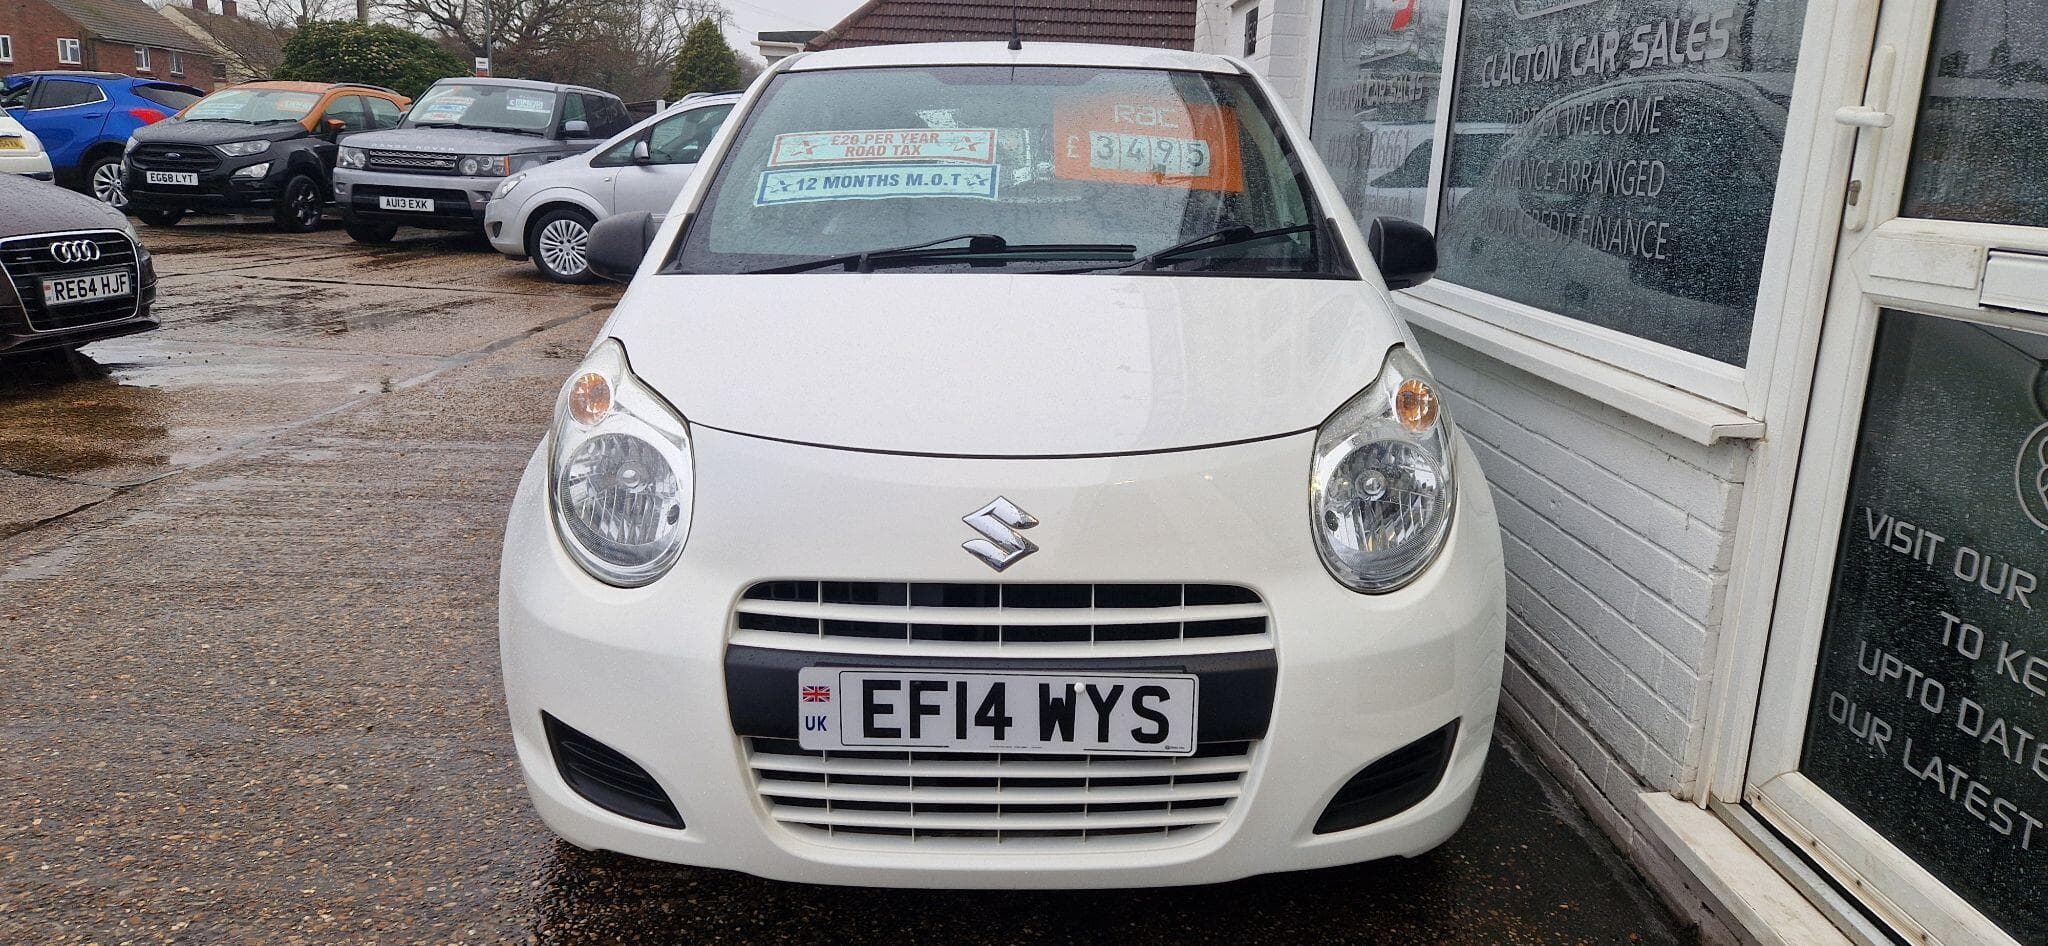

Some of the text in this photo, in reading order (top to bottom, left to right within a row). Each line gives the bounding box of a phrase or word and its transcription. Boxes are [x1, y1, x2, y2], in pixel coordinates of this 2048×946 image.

[1481, 9, 1733, 88] CLACTON CAR SALES
[1366, 78, 1387, 106] CAR
[1385, 72, 1423, 104] SALES
[1565, 95, 1665, 136] WELCOME
[844, 143, 922, 157] ROAD TAX
[864, 134, 894, 145] PER
[900, 132, 939, 144] YEAR
[1096, 135, 1205, 167] 3495
[150, 173, 193, 184] EG68 LYT
[797, 172, 962, 191] 12 MONTHS M.O.T
[1491, 158, 1665, 198] FINANCE ARRANGED
[386, 199, 428, 210] AU13 EXK
[1521, 207, 1577, 246] CREDIT
[1578, 213, 1670, 260] FINANCE
[54, 274, 129, 301] RE64 HJF
[1866, 506, 2037, 610] VISIT OUR
[1941, 611, 1984, 660] TO
[1858, 640, 1945, 714] UPTO
[805, 715, 827, 732] UK
[862, 679, 1171, 745] EF14 WYS
[1828, 690, 2044, 850] OUR LATEST
